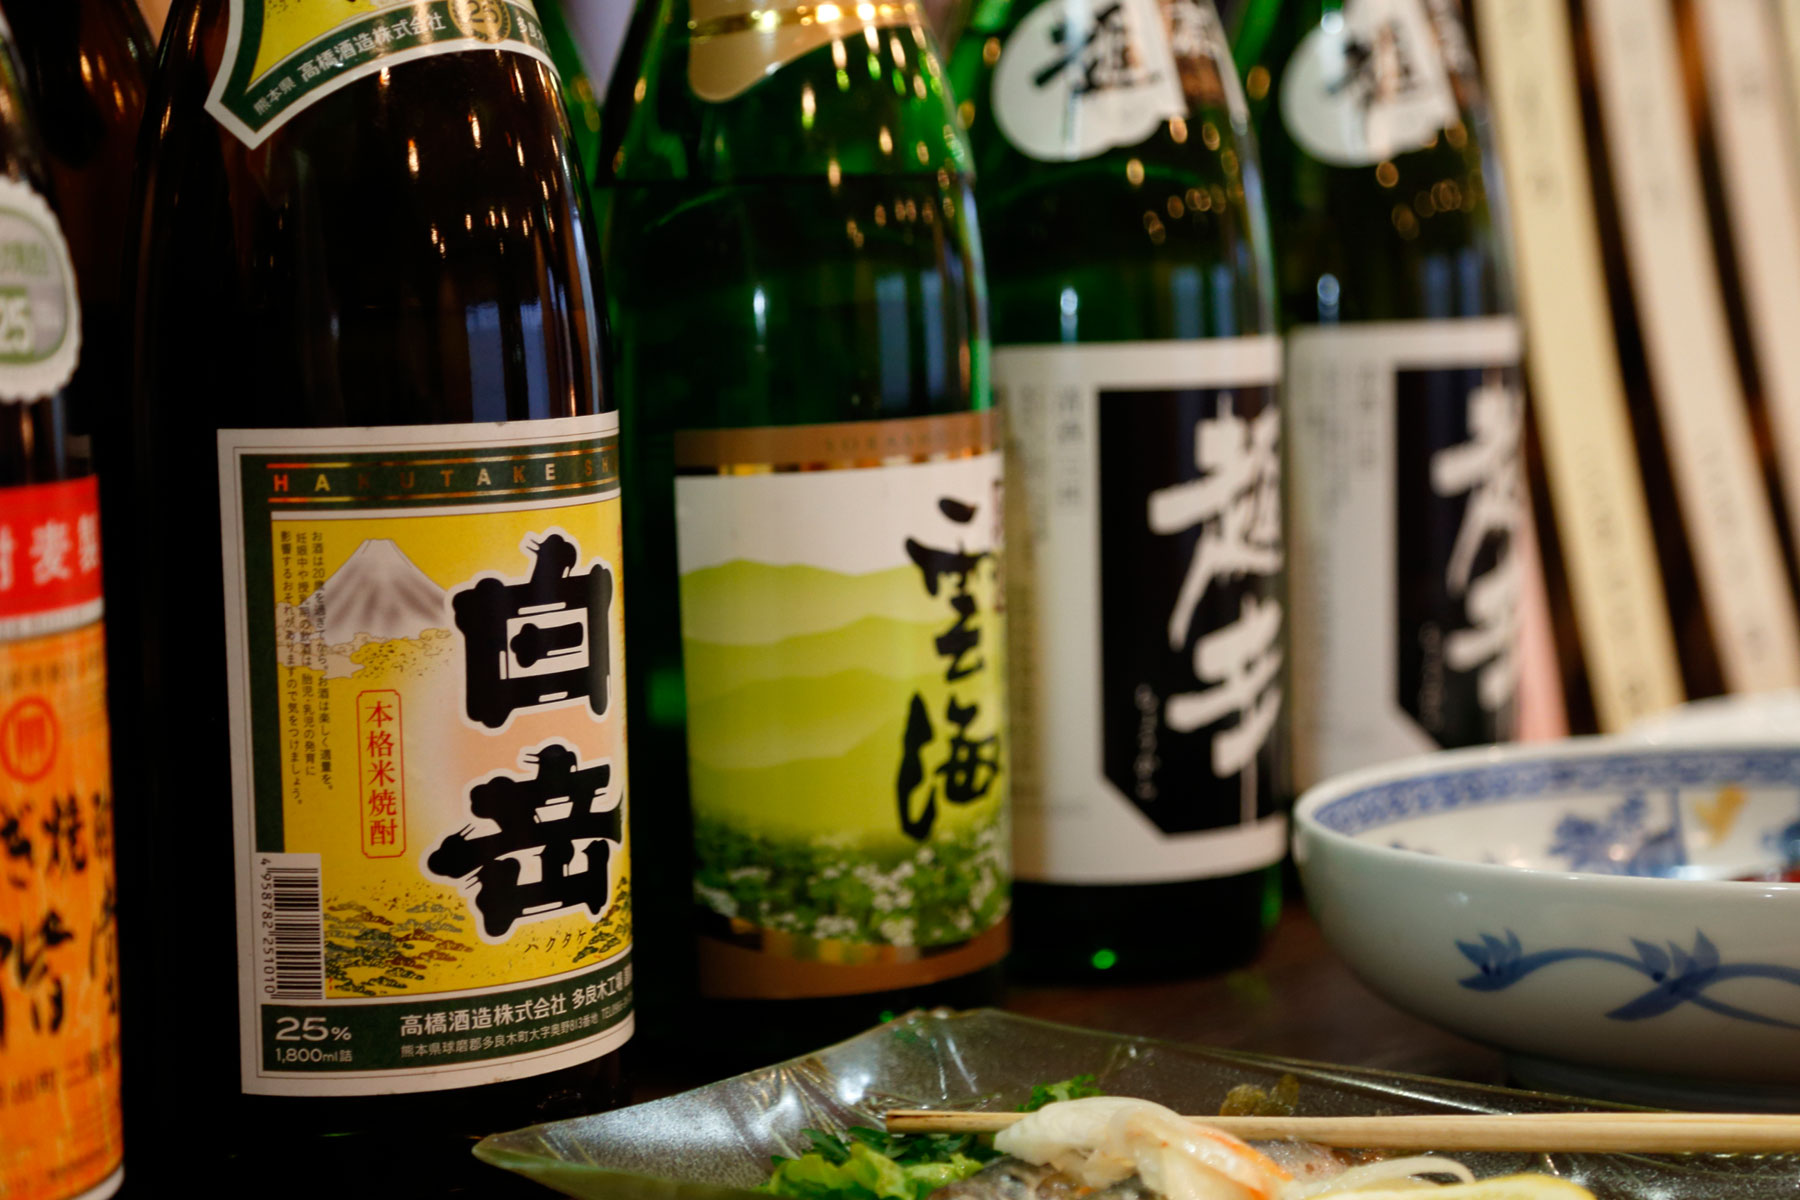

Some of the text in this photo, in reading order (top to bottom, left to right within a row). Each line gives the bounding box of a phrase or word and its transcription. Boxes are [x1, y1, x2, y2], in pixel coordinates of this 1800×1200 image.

[253, 76, 296, 116] 熊本県
[297, 12, 447, 82] 高橋酒造株式会社
[427, 533, 624, 938] 白岳
[365, 700, 398, 846] 本格米焼酎
[524, 930, 588, 954] ハクタケ
[275, 1016, 352, 1041] 25%
[400, 993, 568, 1037] 高橋酒造株式会社
